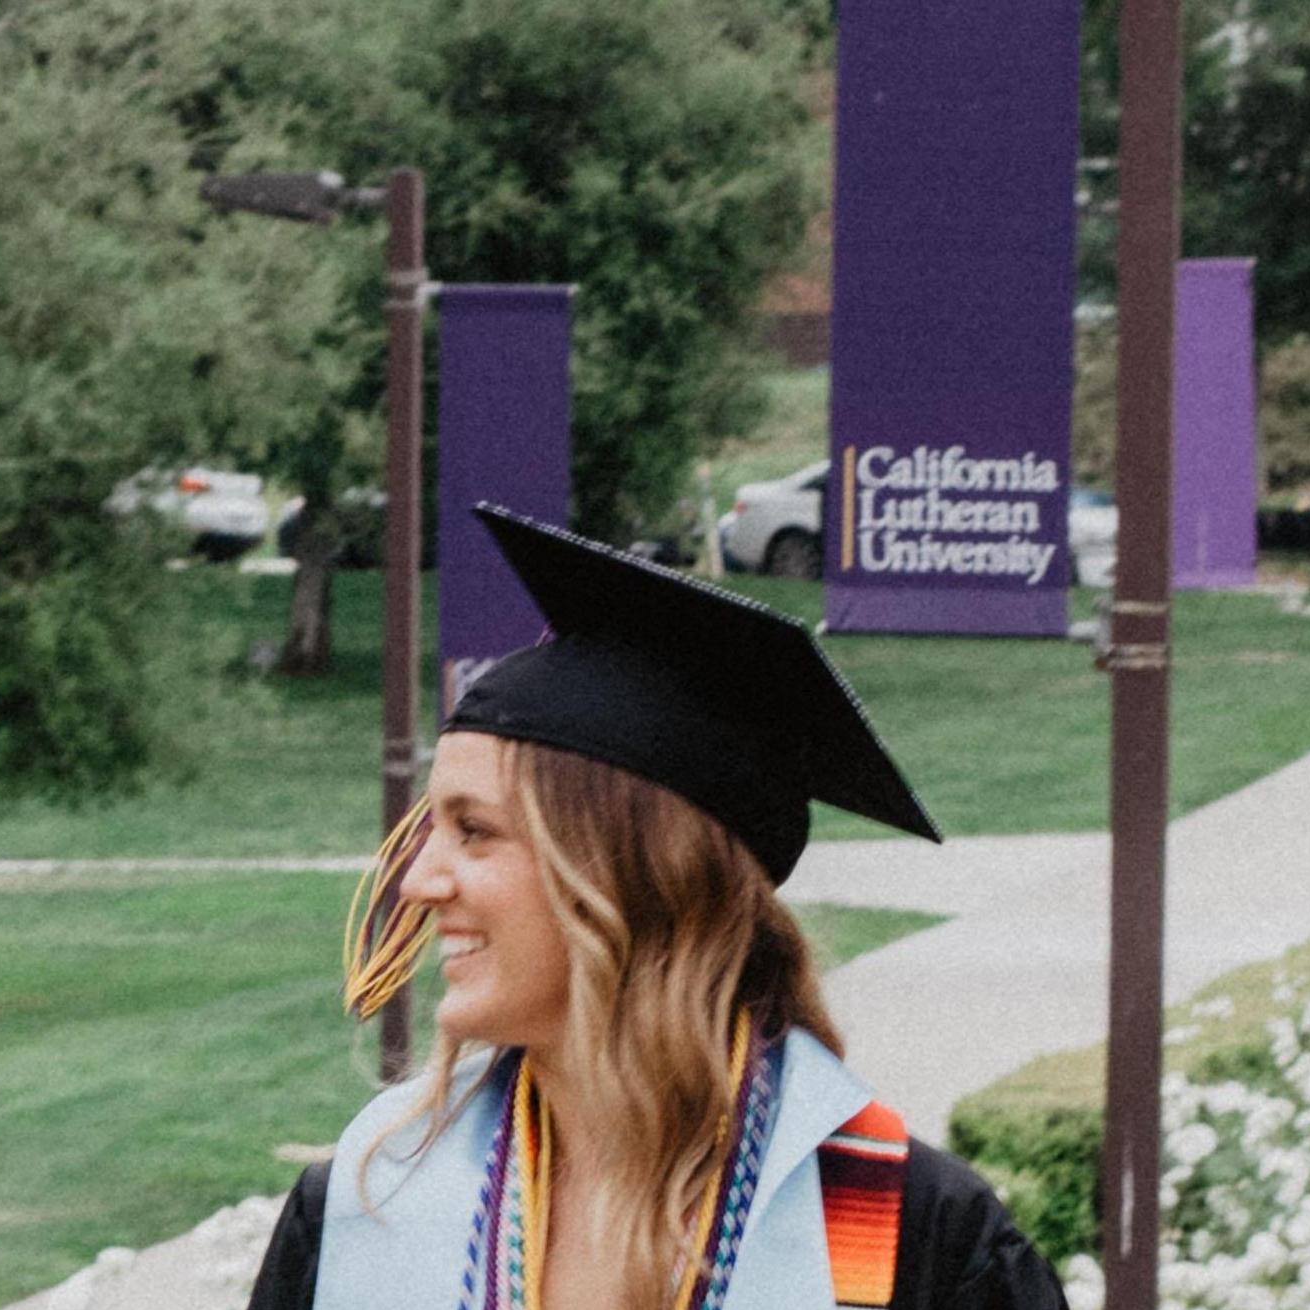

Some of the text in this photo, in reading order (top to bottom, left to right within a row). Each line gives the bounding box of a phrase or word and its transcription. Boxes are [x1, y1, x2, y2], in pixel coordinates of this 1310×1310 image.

[856, 446, 1060, 492] California
[859, 487, 1039, 533] Lutheran
[859, 530, 1056, 585] University
